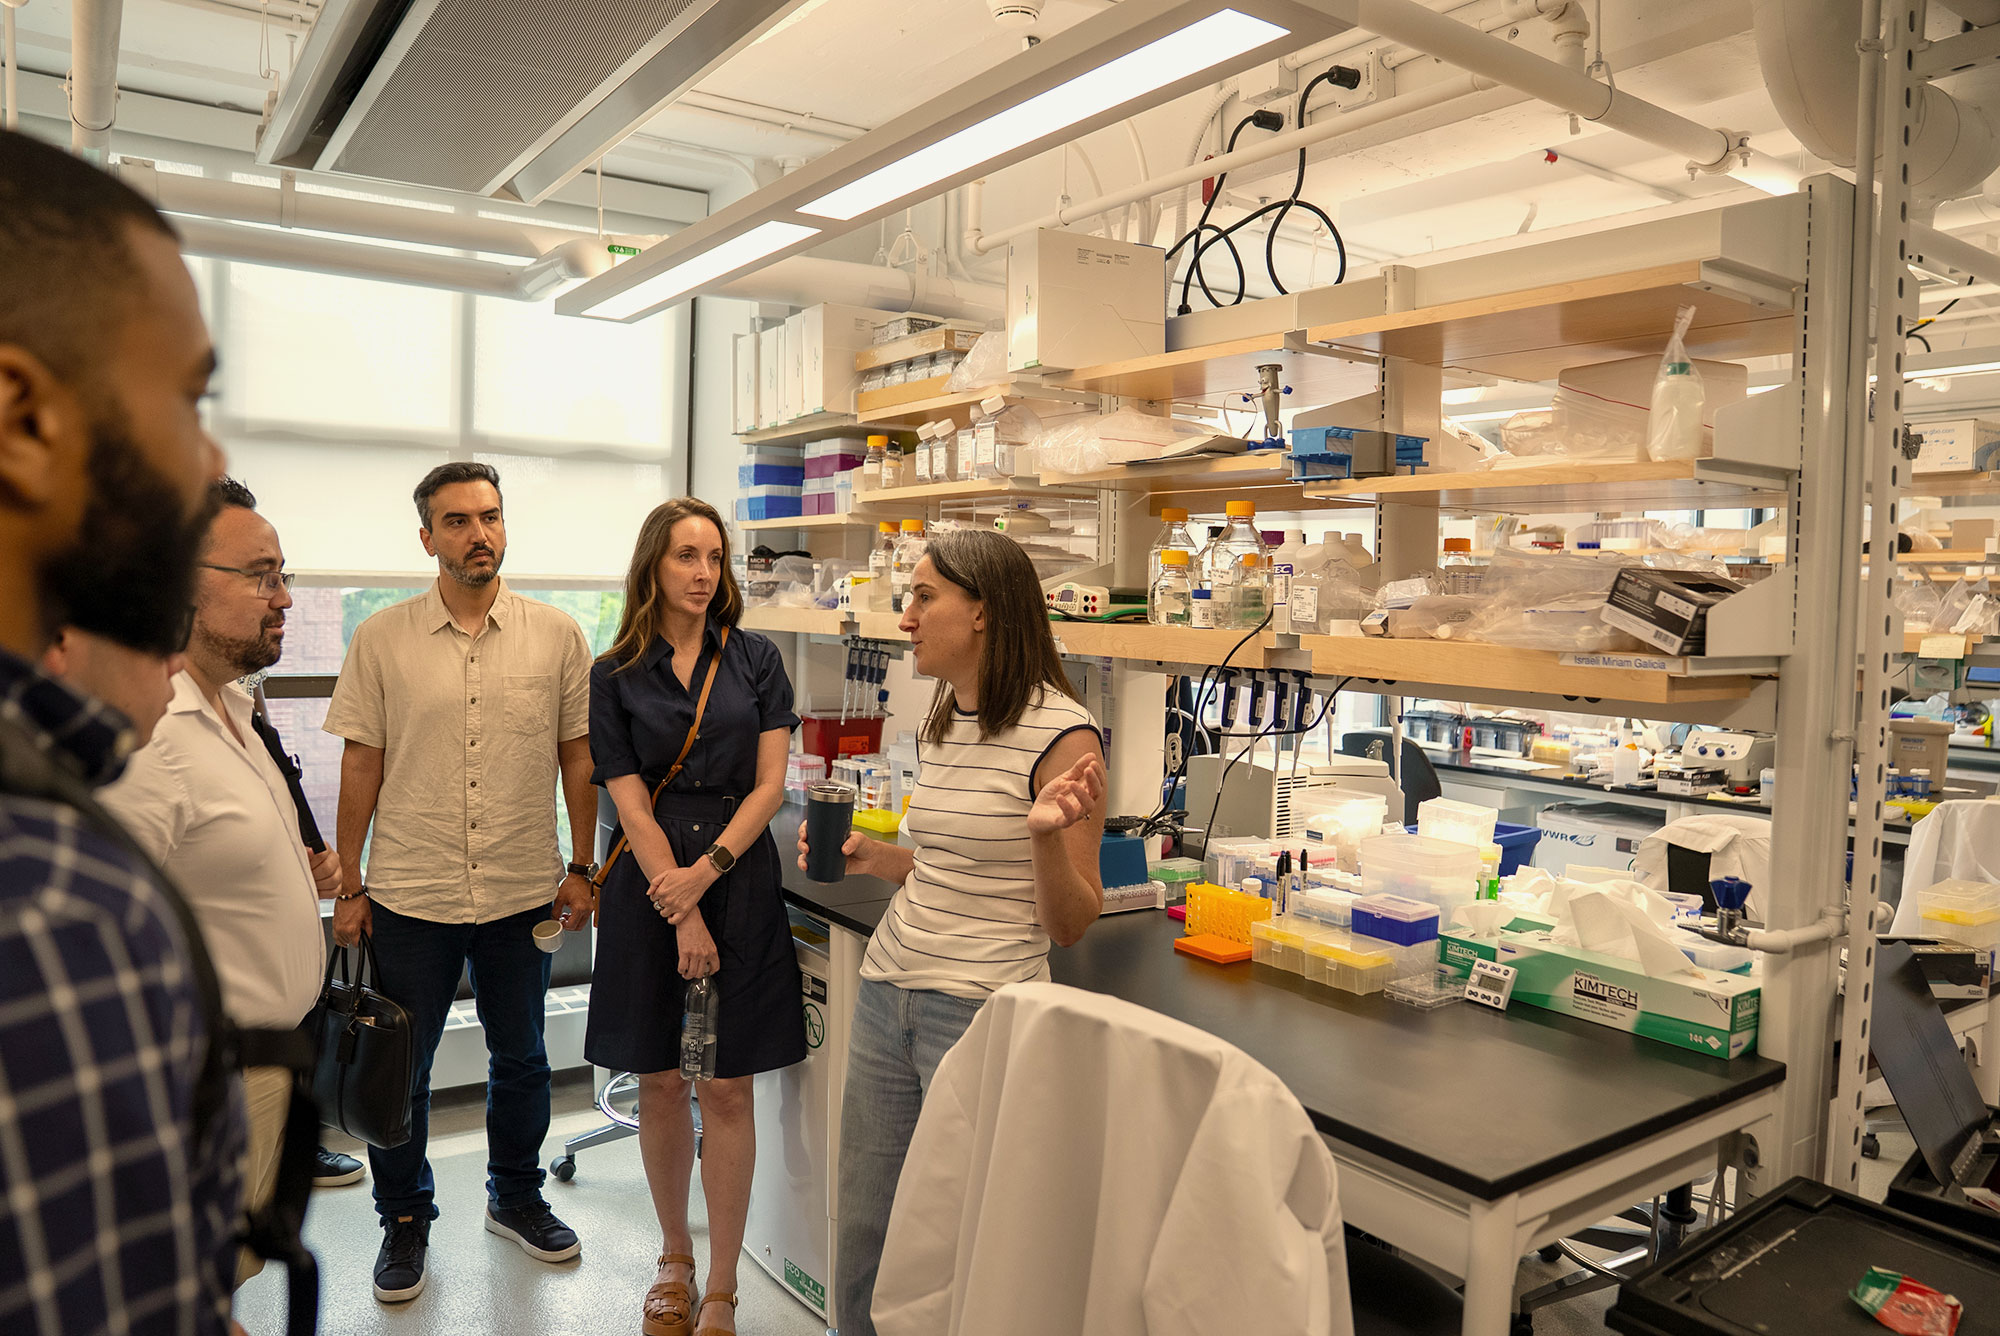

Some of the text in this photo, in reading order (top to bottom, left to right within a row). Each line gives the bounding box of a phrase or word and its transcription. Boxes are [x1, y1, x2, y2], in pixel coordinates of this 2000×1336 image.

[1634, 658, 1666, 669] Galicia
[1541, 829, 1568, 841] VWR
[1447, 943, 1478, 957] KIMTECH
[1574, 976, 1638, 1003] KIMTECH
[1737, 998, 1760, 1013] KIMTE
[785, 1260, 800, 1278] eco
